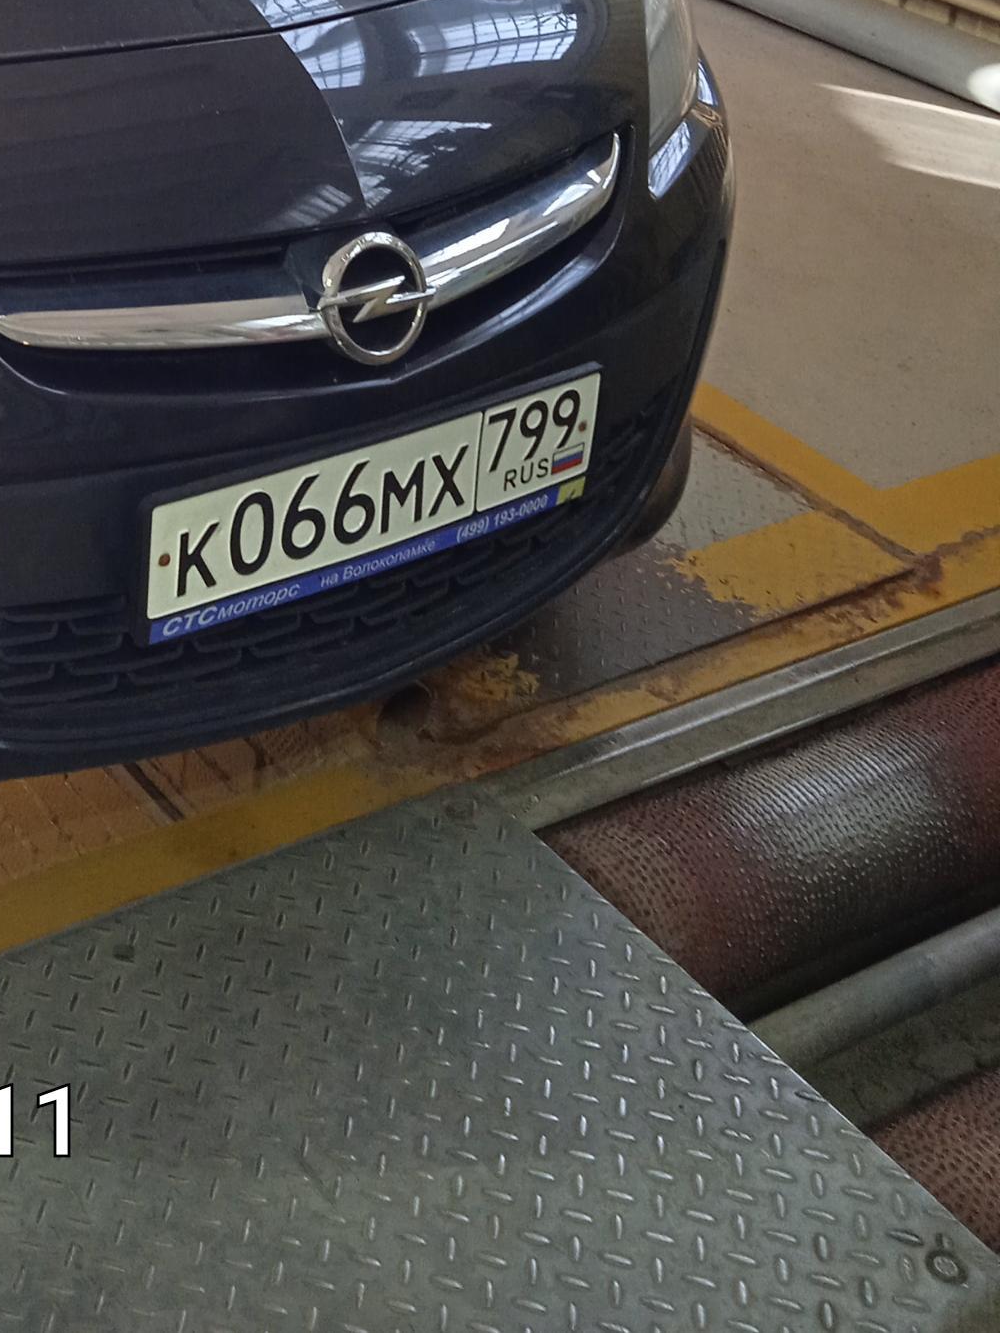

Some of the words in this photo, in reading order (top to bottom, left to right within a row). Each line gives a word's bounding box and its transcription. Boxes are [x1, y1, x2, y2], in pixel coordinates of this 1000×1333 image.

[176, 444, 470, 598] К066МХ
[487, 388, 581, 474] 799
[503, 457, 549, 492] RUS
[319, 574, 339, 589] на
[456, 515, 490, 543] (499)
[493, 493, 550, 528] 193-0000
